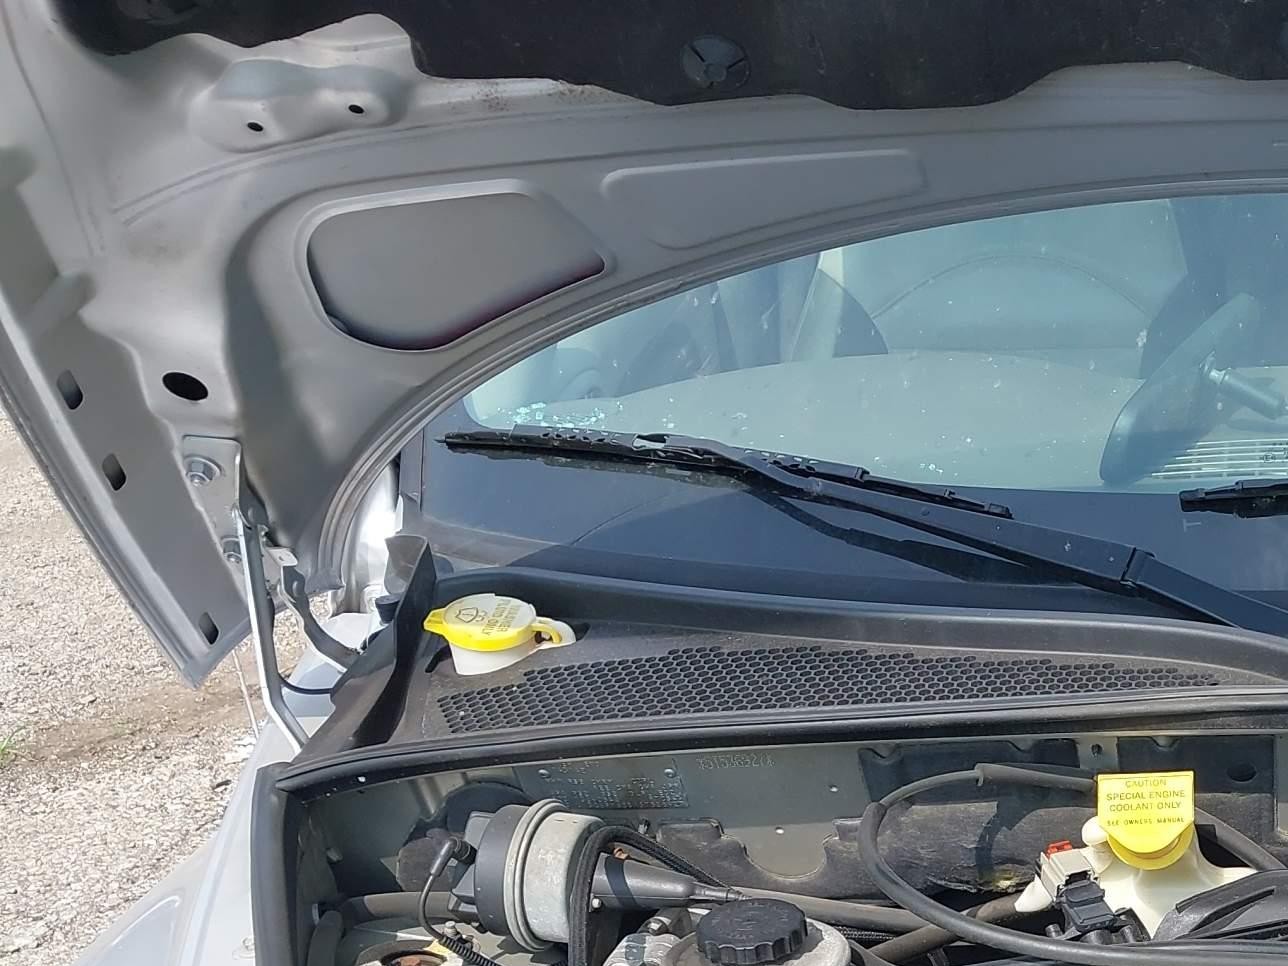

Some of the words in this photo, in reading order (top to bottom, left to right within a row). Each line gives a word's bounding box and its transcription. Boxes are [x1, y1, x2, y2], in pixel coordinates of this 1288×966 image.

[1124, 779, 1167, 788] CAUTION
[1106, 791, 1147, 801] SPECIAL
[1149, 789, 1185, 799] ENGINE
[1109, 802, 1153, 812] COOLANT
[1157, 801, 1182, 810] ONLY
